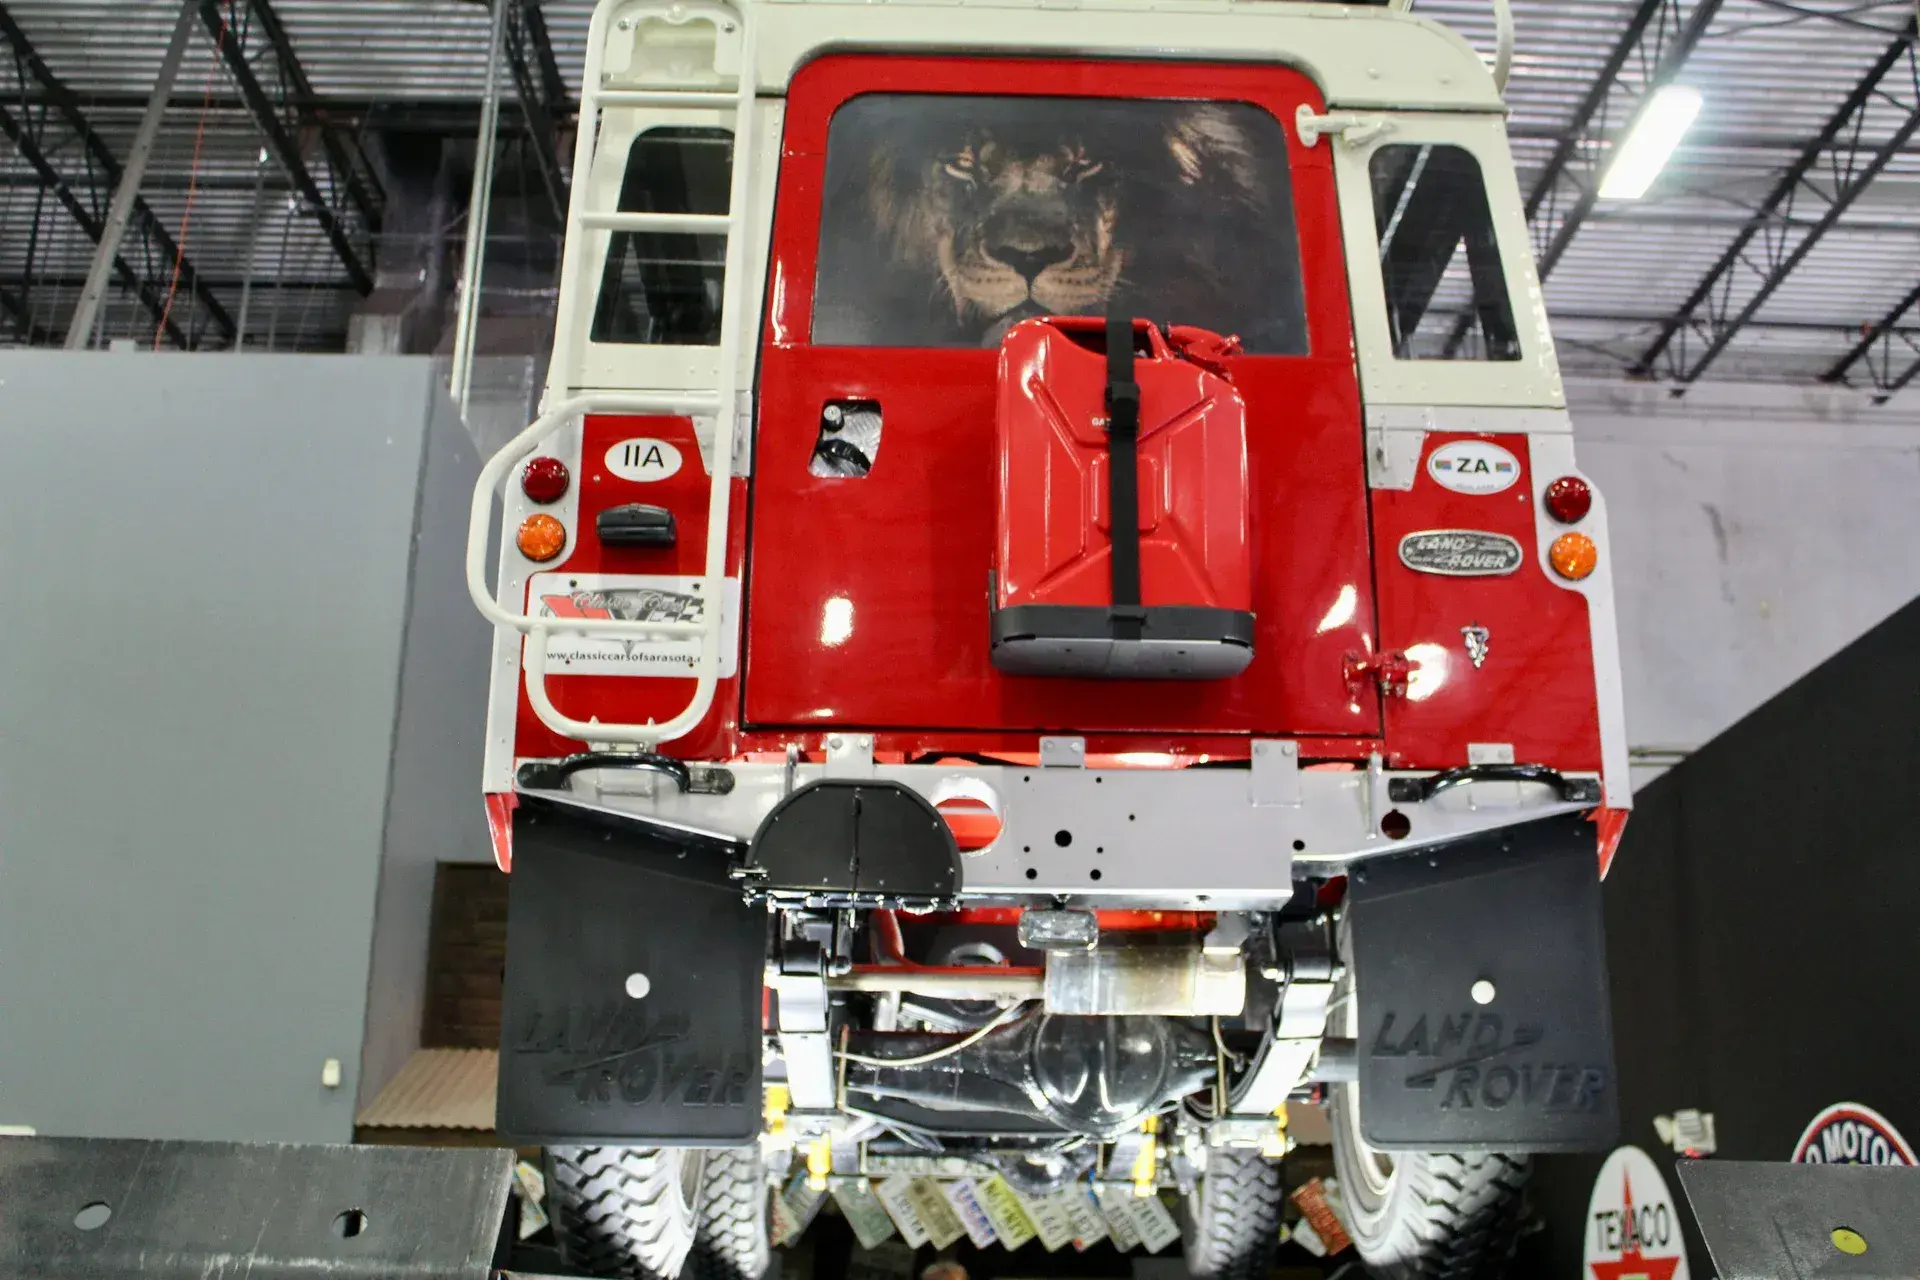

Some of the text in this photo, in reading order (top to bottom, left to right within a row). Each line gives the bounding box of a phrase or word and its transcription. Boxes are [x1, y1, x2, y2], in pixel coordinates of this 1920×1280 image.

[624, 444, 664, 468] IIA
[1457, 457, 1490, 474] ZA
[1417, 537, 1468, 551] LAND
[1447, 553, 1508, 569] ROVER
[1369, 1010, 1504, 1057] LAND
[1439, 1061, 1609, 1114] ROVER
[1595, 1203, 1671, 1252] TEXACO
